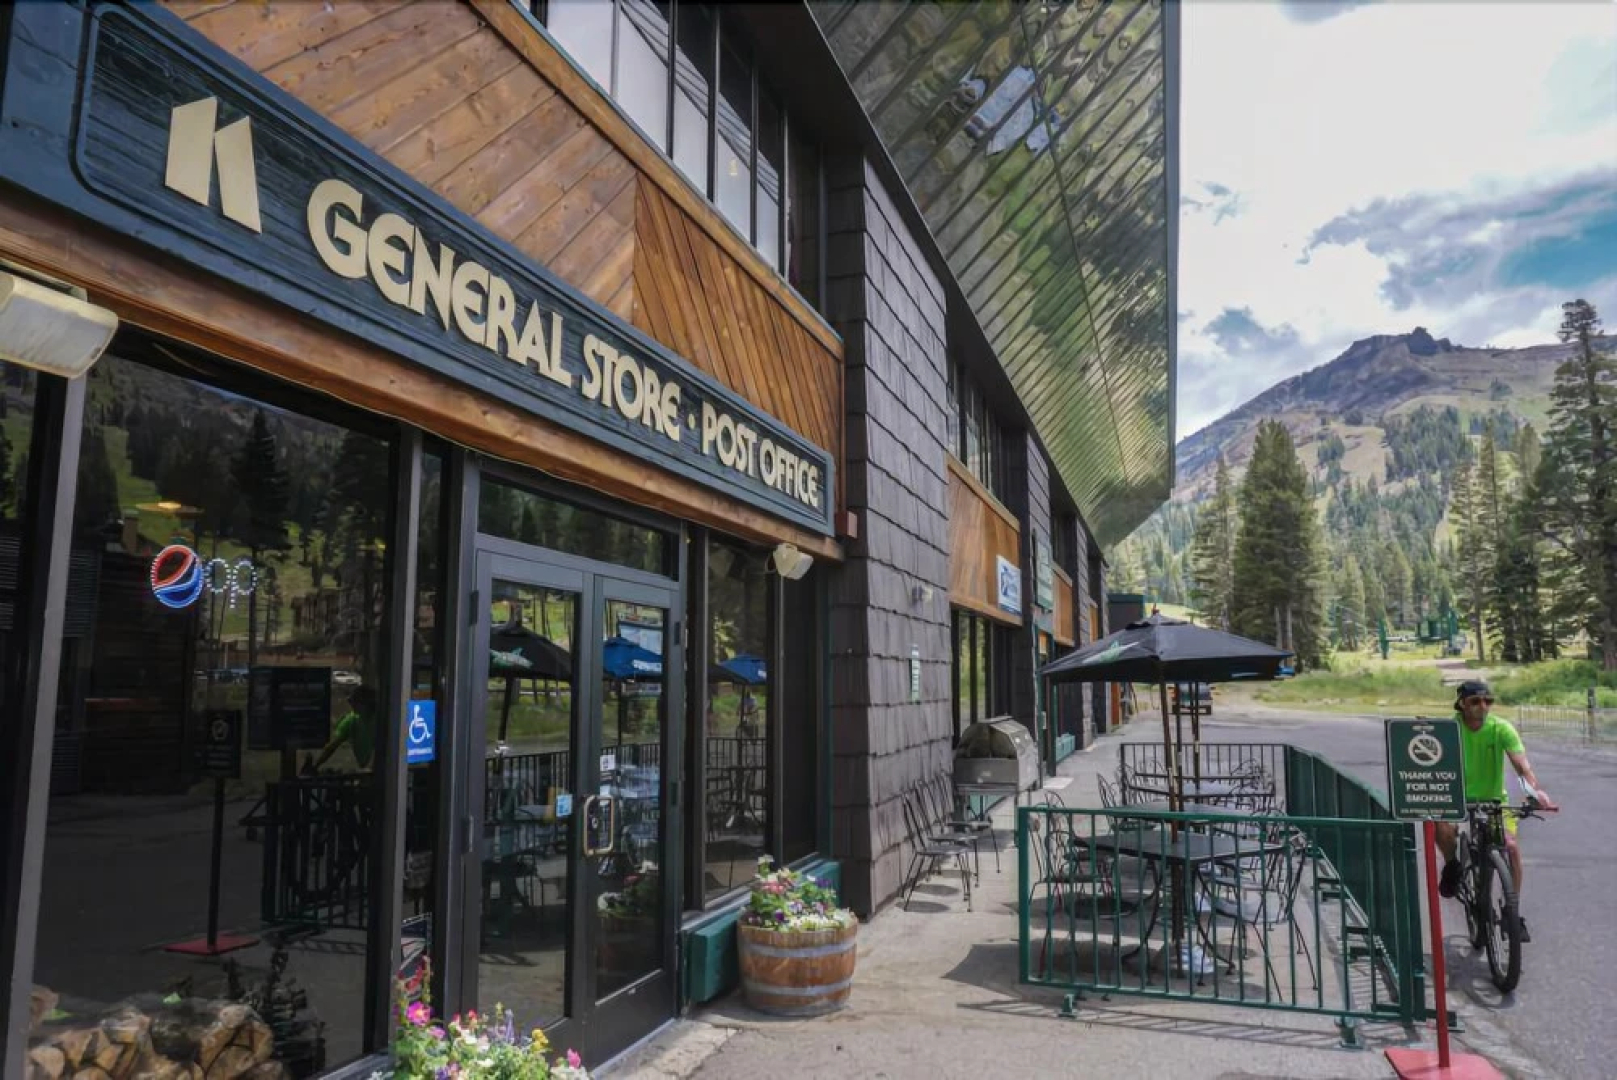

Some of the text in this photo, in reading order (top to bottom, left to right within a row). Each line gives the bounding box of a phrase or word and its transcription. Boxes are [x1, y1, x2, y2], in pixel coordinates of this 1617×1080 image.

[307, 179, 818, 508] GENERAL STORE POST OFFICE
[1399, 771, 1456, 780] THANK YOU
[1406, 783, 1449, 792] FOR NOT
[1406, 794, 1453, 803] SMOKING
